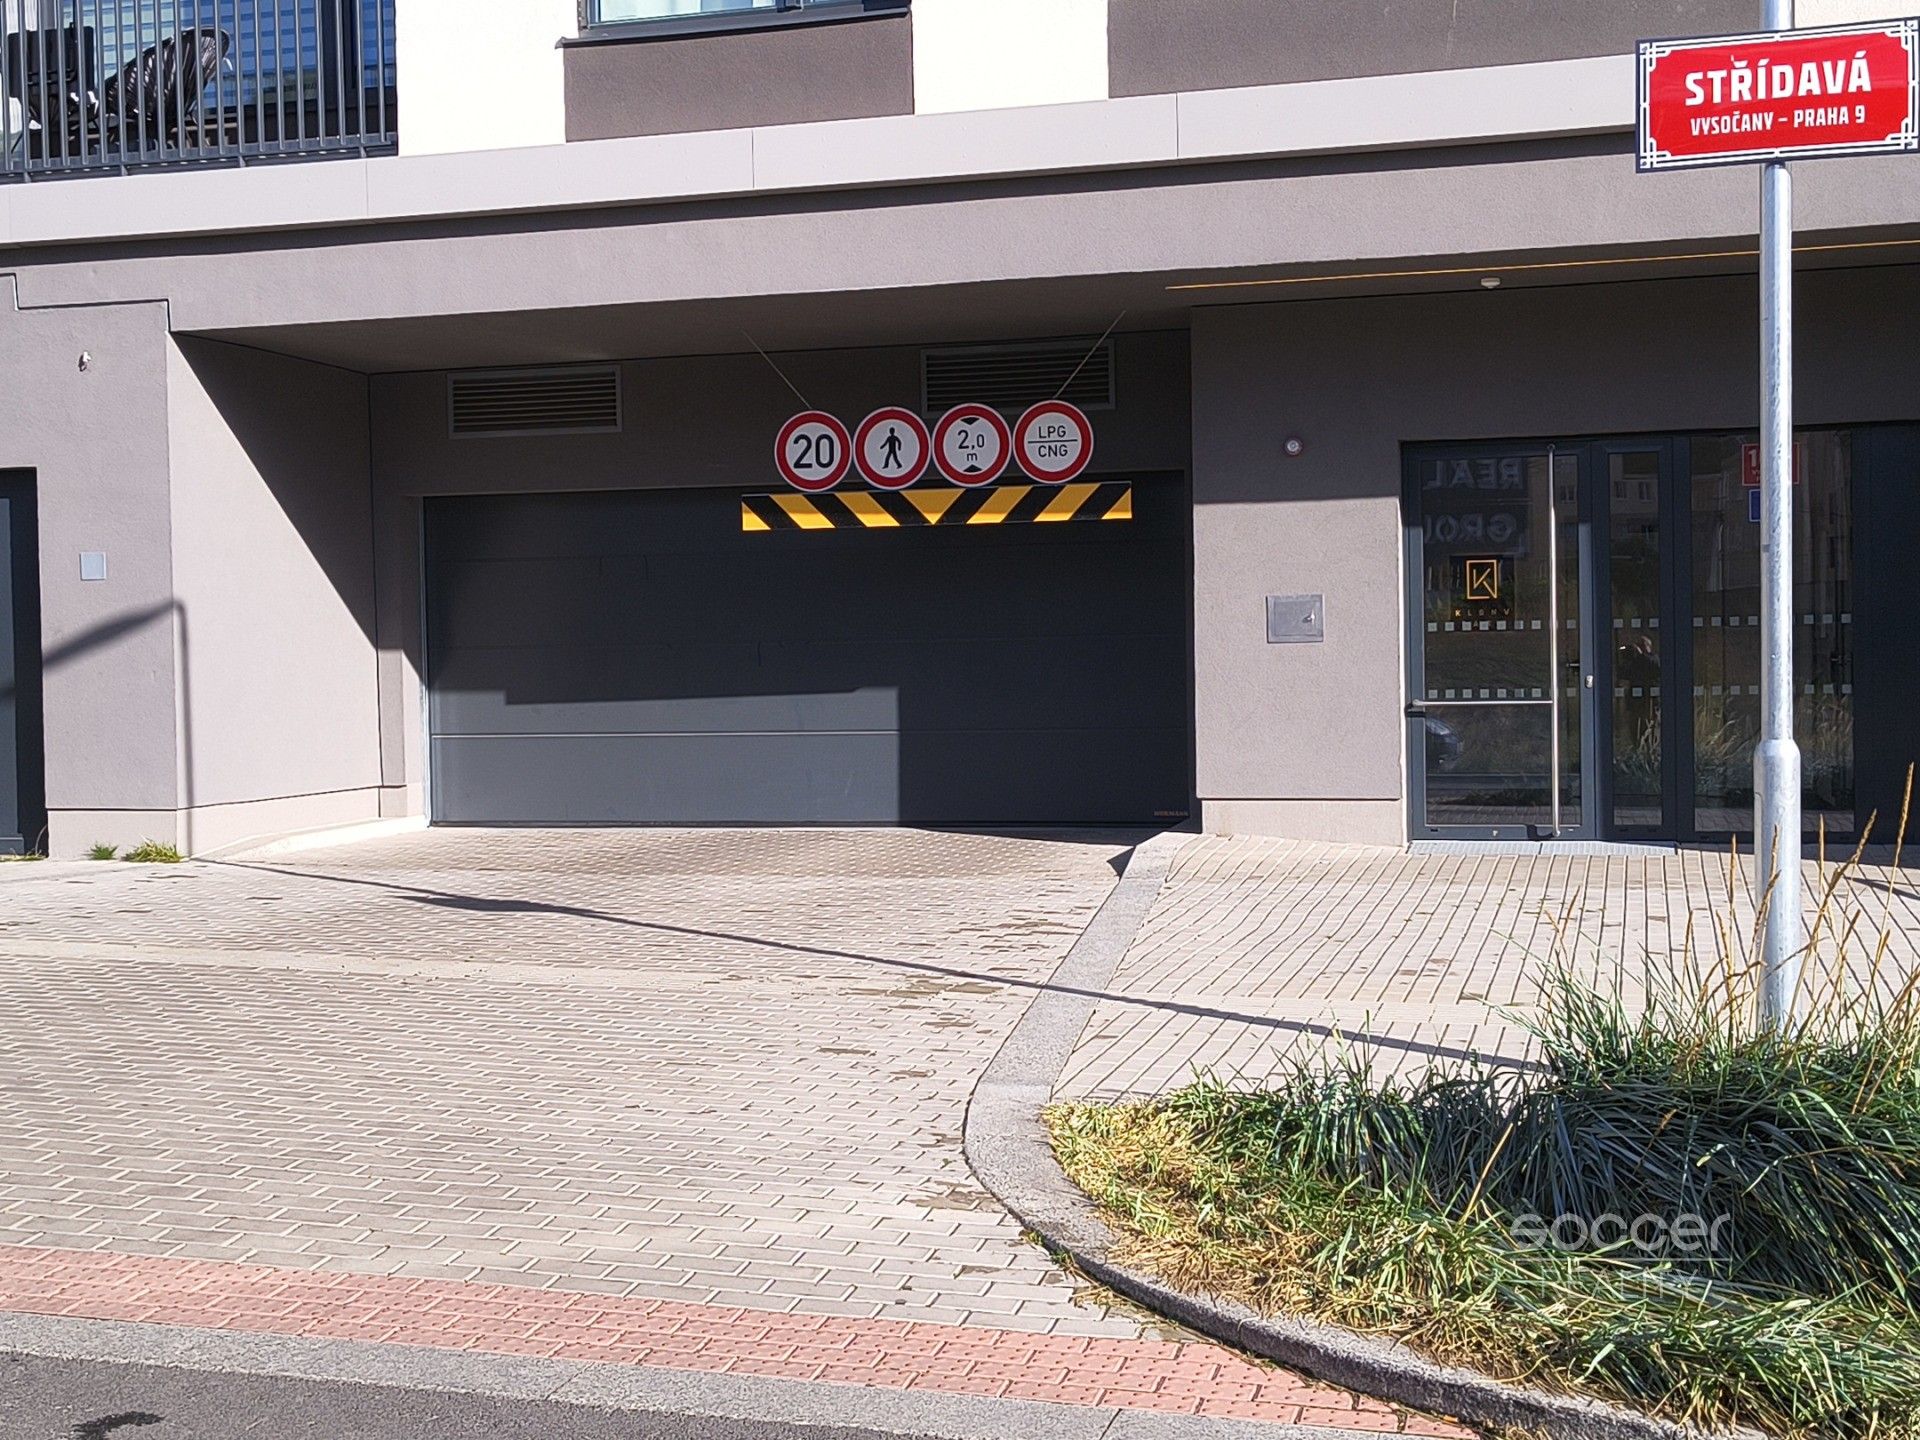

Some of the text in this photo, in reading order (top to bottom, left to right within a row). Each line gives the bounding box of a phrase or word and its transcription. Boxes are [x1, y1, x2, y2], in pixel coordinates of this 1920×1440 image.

[1684, 50, 1872, 106] STŘÍDAVÁ
[1690, 111, 1774, 137] VYSOČANY
[1793, 107, 1850, 128] PRAHA
[1855, 105, 1866, 124] 9
[957, 429, 985, 450] 2,0
[1038, 425, 1067, 439] LPG
[793, 433, 835, 469] 20
[966, 452, 978, 462] m
[1037, 444, 1068, 458] CNG
